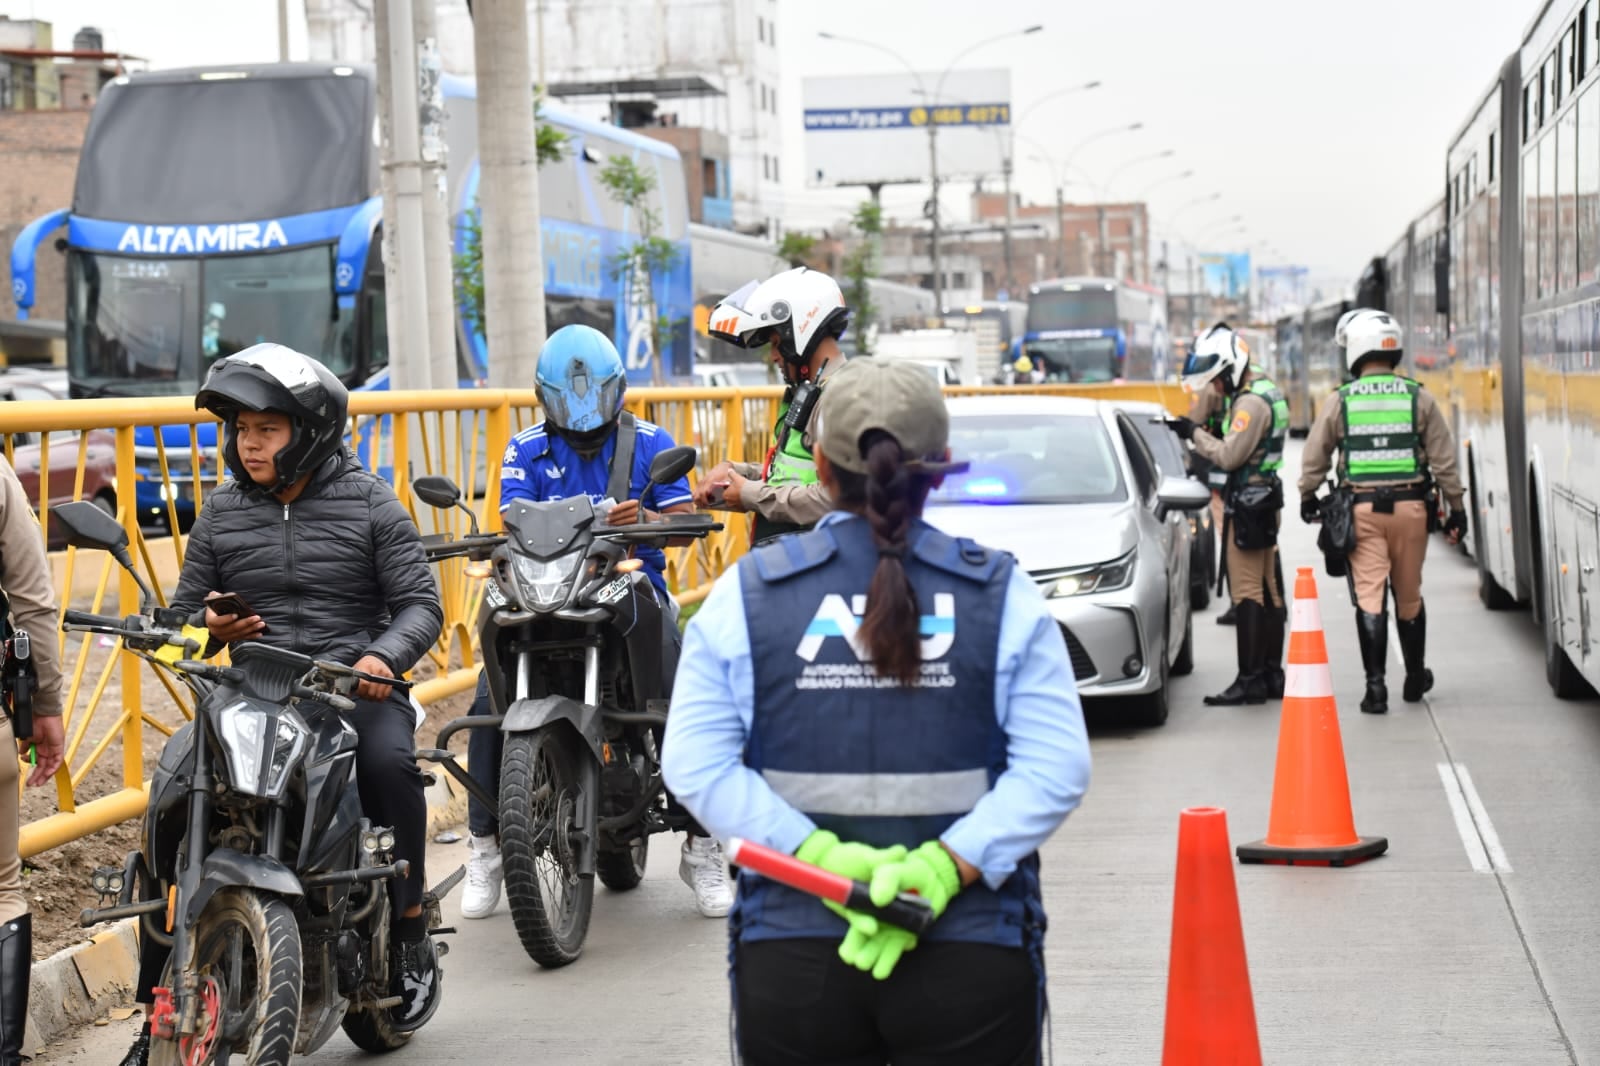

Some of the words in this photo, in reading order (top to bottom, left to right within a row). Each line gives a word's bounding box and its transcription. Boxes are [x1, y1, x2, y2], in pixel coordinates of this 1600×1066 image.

[117, 221, 288, 253] ALTAMIRA
[541, 229, 601, 289] MIRA
[796, 593, 955, 662] AU
[795, 677, 842, 689] URBANO
[844, 677, 873, 688] PARA
[802, 664, 862, 676] AUTORIDAD
